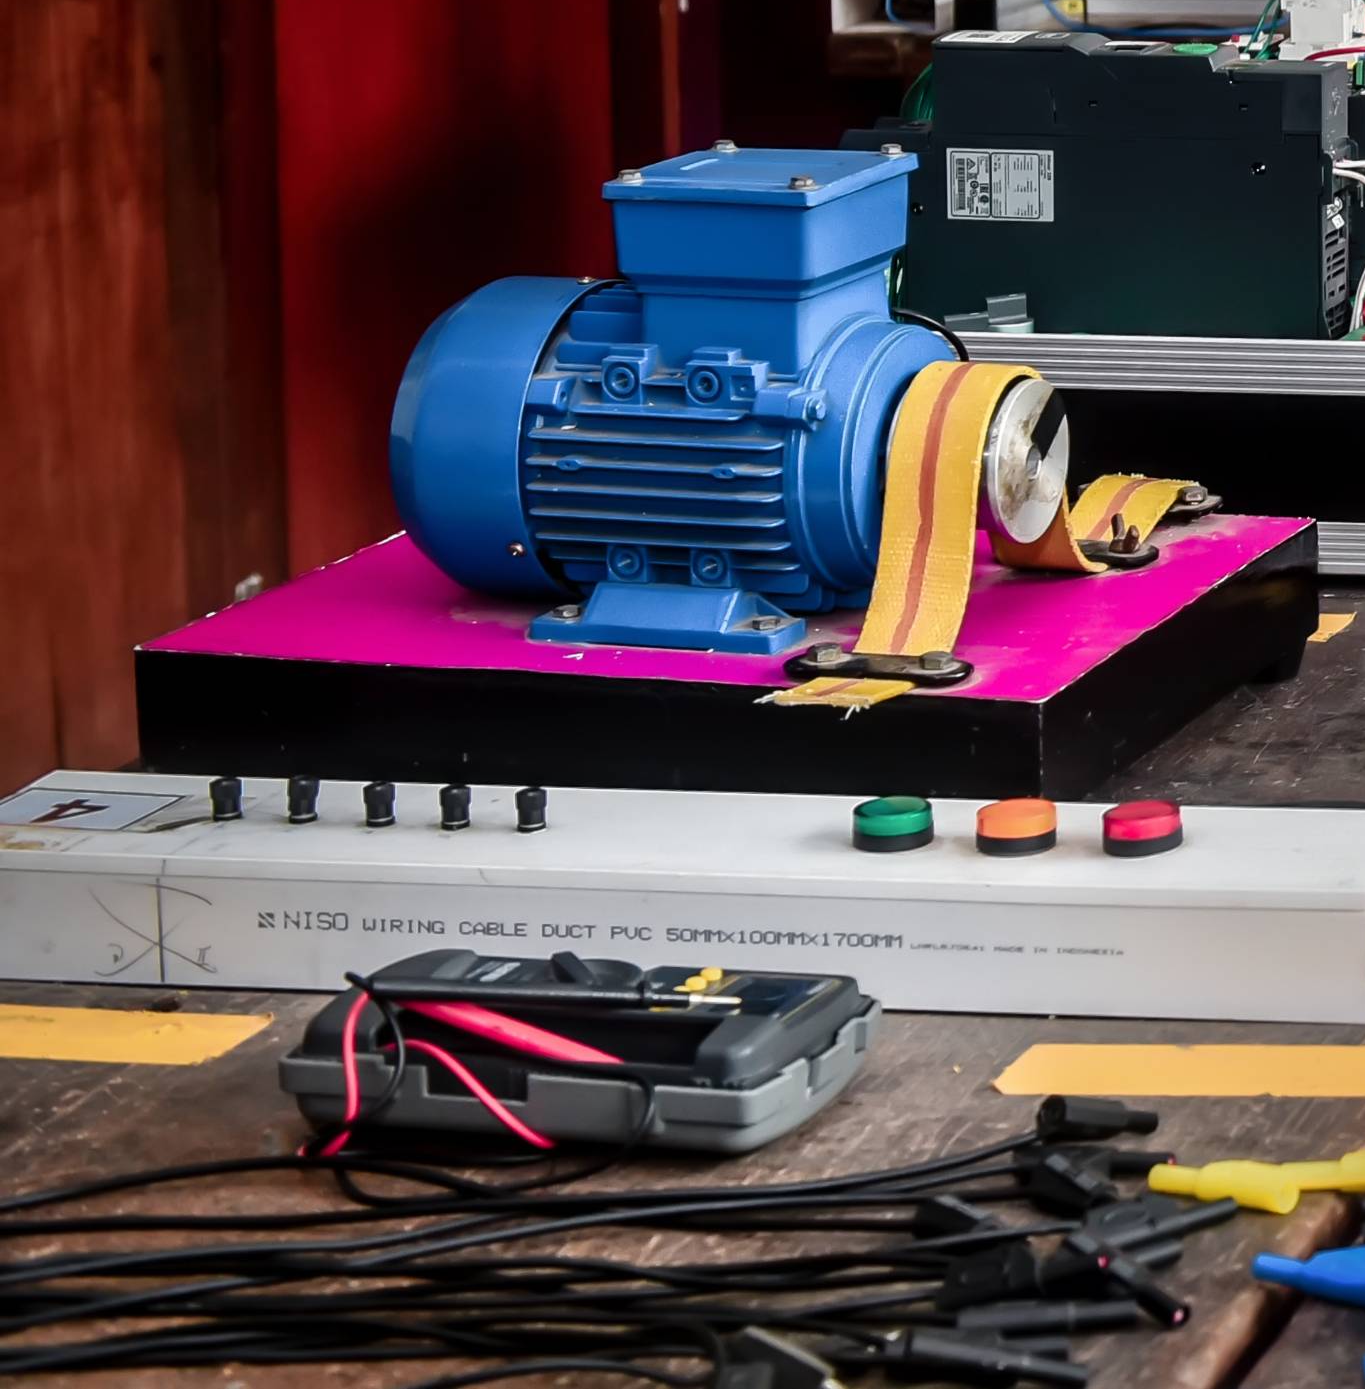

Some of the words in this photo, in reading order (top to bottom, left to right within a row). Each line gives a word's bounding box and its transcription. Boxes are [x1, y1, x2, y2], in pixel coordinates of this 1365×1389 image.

[282, 911, 349, 931] NISO
[362, 918, 446, 935] WIRING
[458, 920, 528, 938] CABLE
[541, 923, 597, 940] DUCT
[610, 926, 652, 942] PVC
